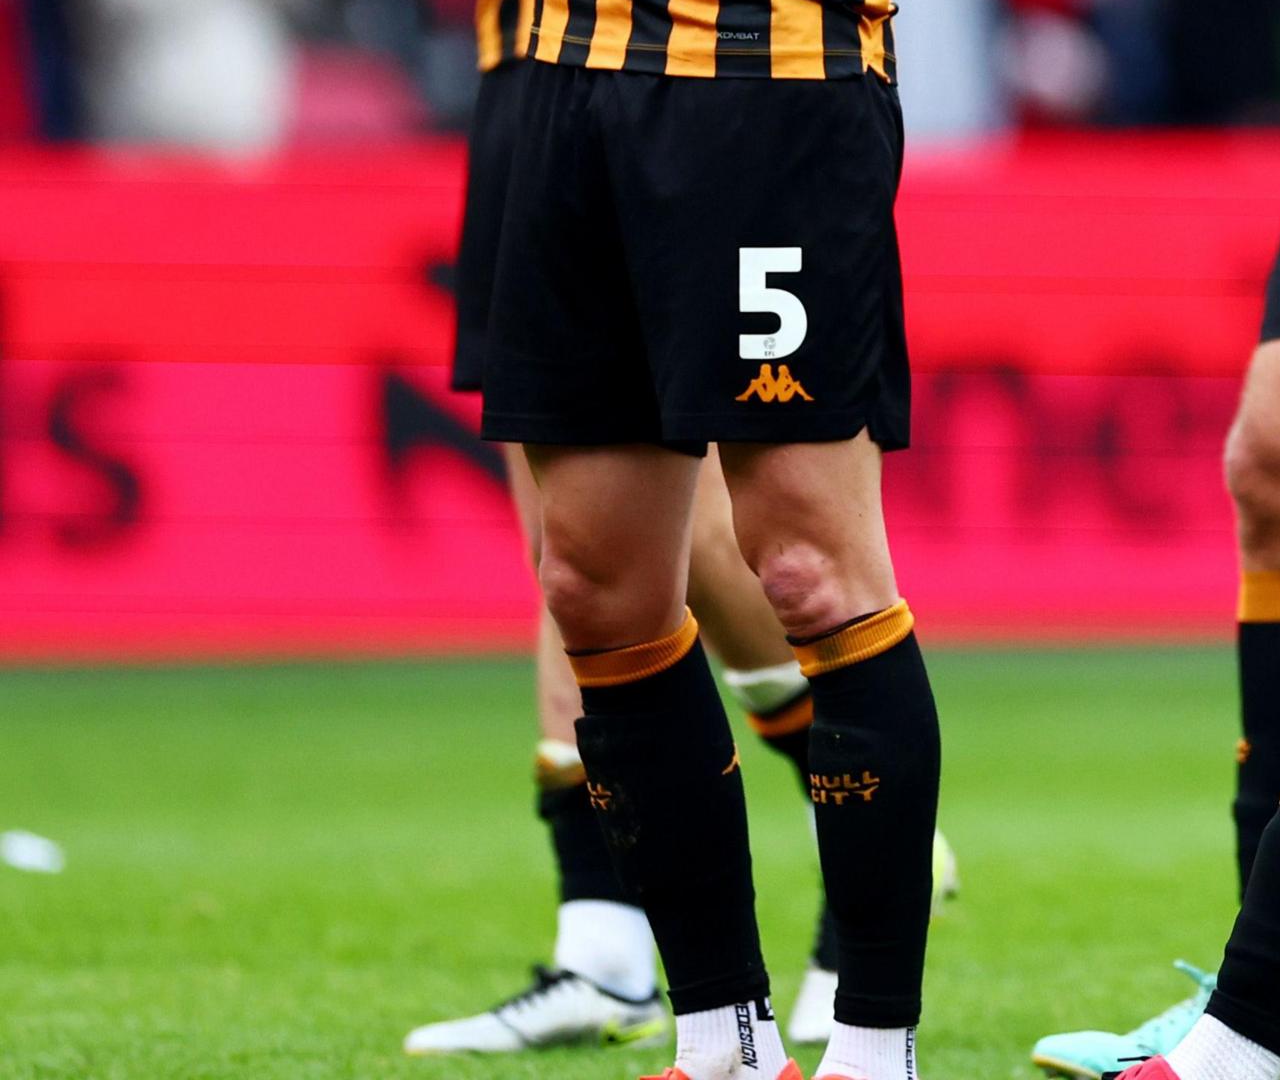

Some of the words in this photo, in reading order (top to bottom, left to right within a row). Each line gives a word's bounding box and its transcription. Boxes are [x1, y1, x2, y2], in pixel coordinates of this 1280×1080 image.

[739, 246, 808, 360] 5
[809, 771, 880, 788] HULL
[811, 785, 879, 806] CITY
